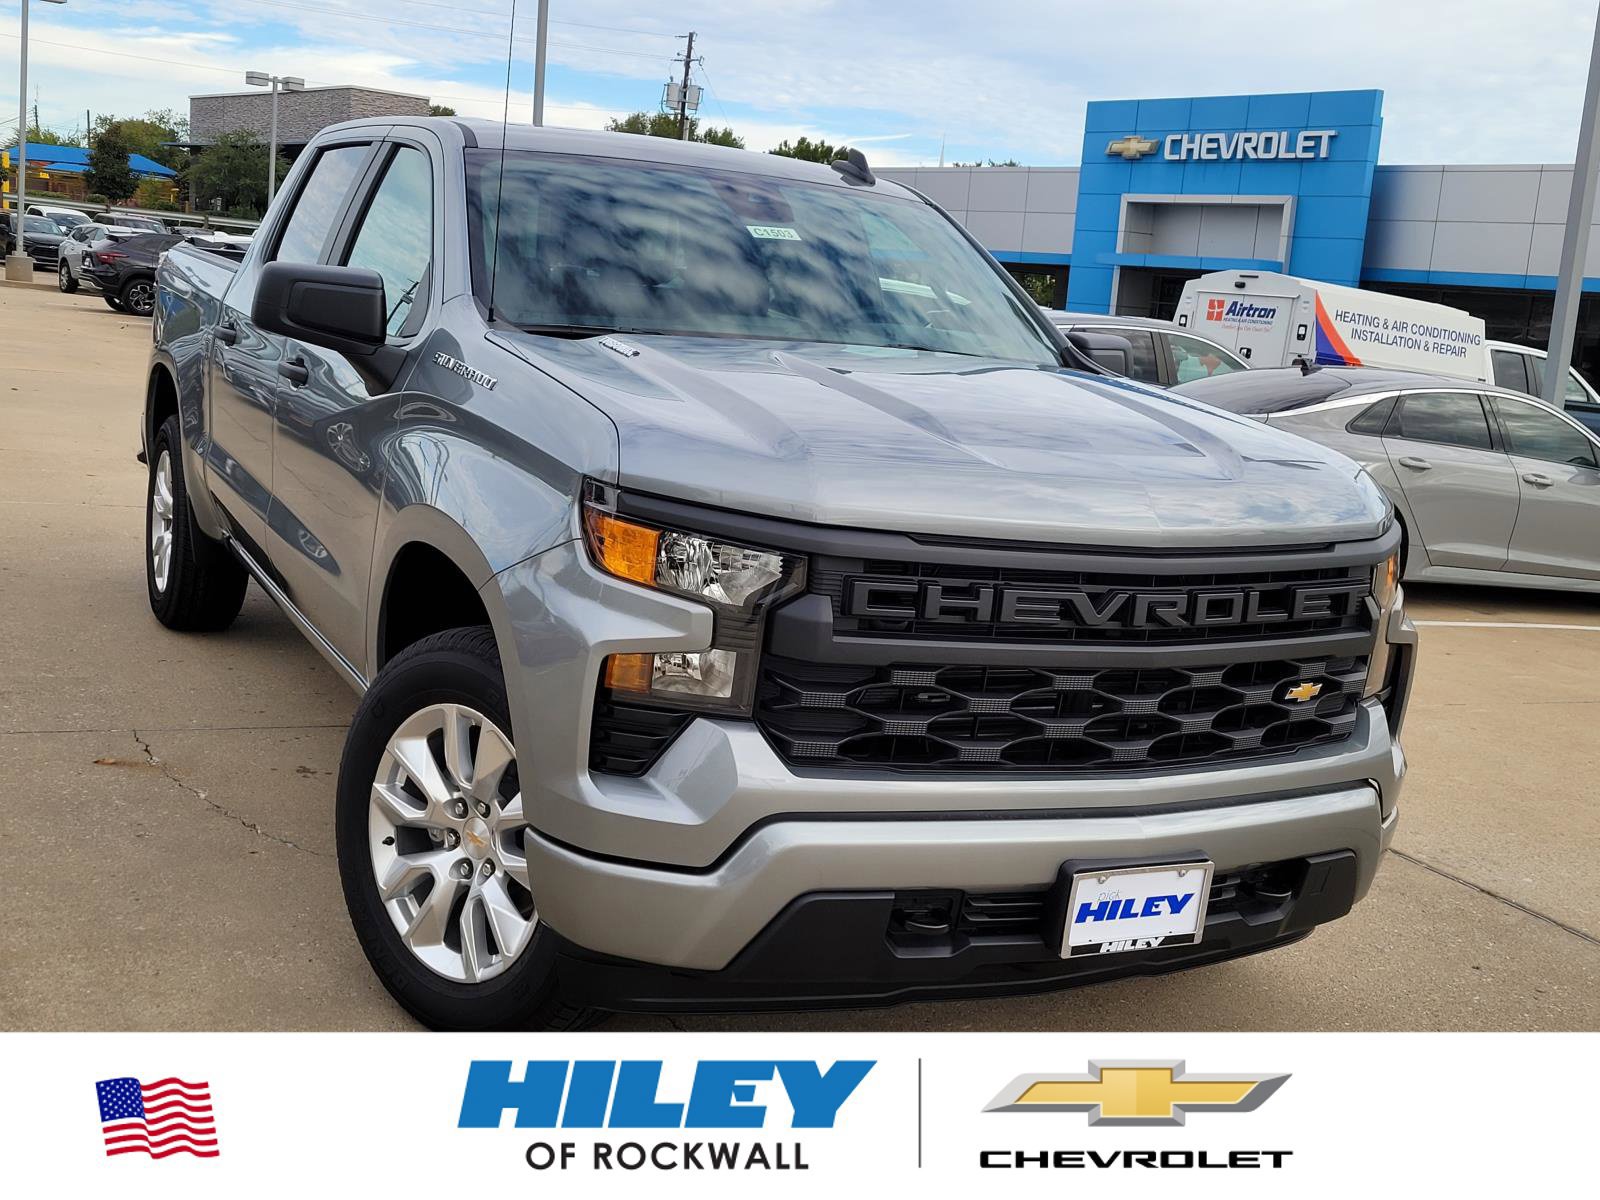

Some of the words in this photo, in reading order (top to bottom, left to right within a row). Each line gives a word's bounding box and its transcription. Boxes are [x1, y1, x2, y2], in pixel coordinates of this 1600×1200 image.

[1164, 130, 1338, 161] CHEVROLET
[753, 227, 794, 239] C1503
[1225, 300, 1277, 319] Airtron
[1334, 309, 1380, 328] HEATING
[1382, 318, 1389, 330] &
[1391, 319, 1409, 333] AIR
[1410, 323, 1481, 346] CONDITIONING
[1350, 327, 1421, 350] INSTALLATION
[1423, 340, 1430, 352] &
[1432, 341, 1467, 358] REPAIR
[849, 578, 1370, 628] CHEVROLET
[1075, 893, 1194, 924] HILEY
[1099, 936, 1166, 953] HILEY
